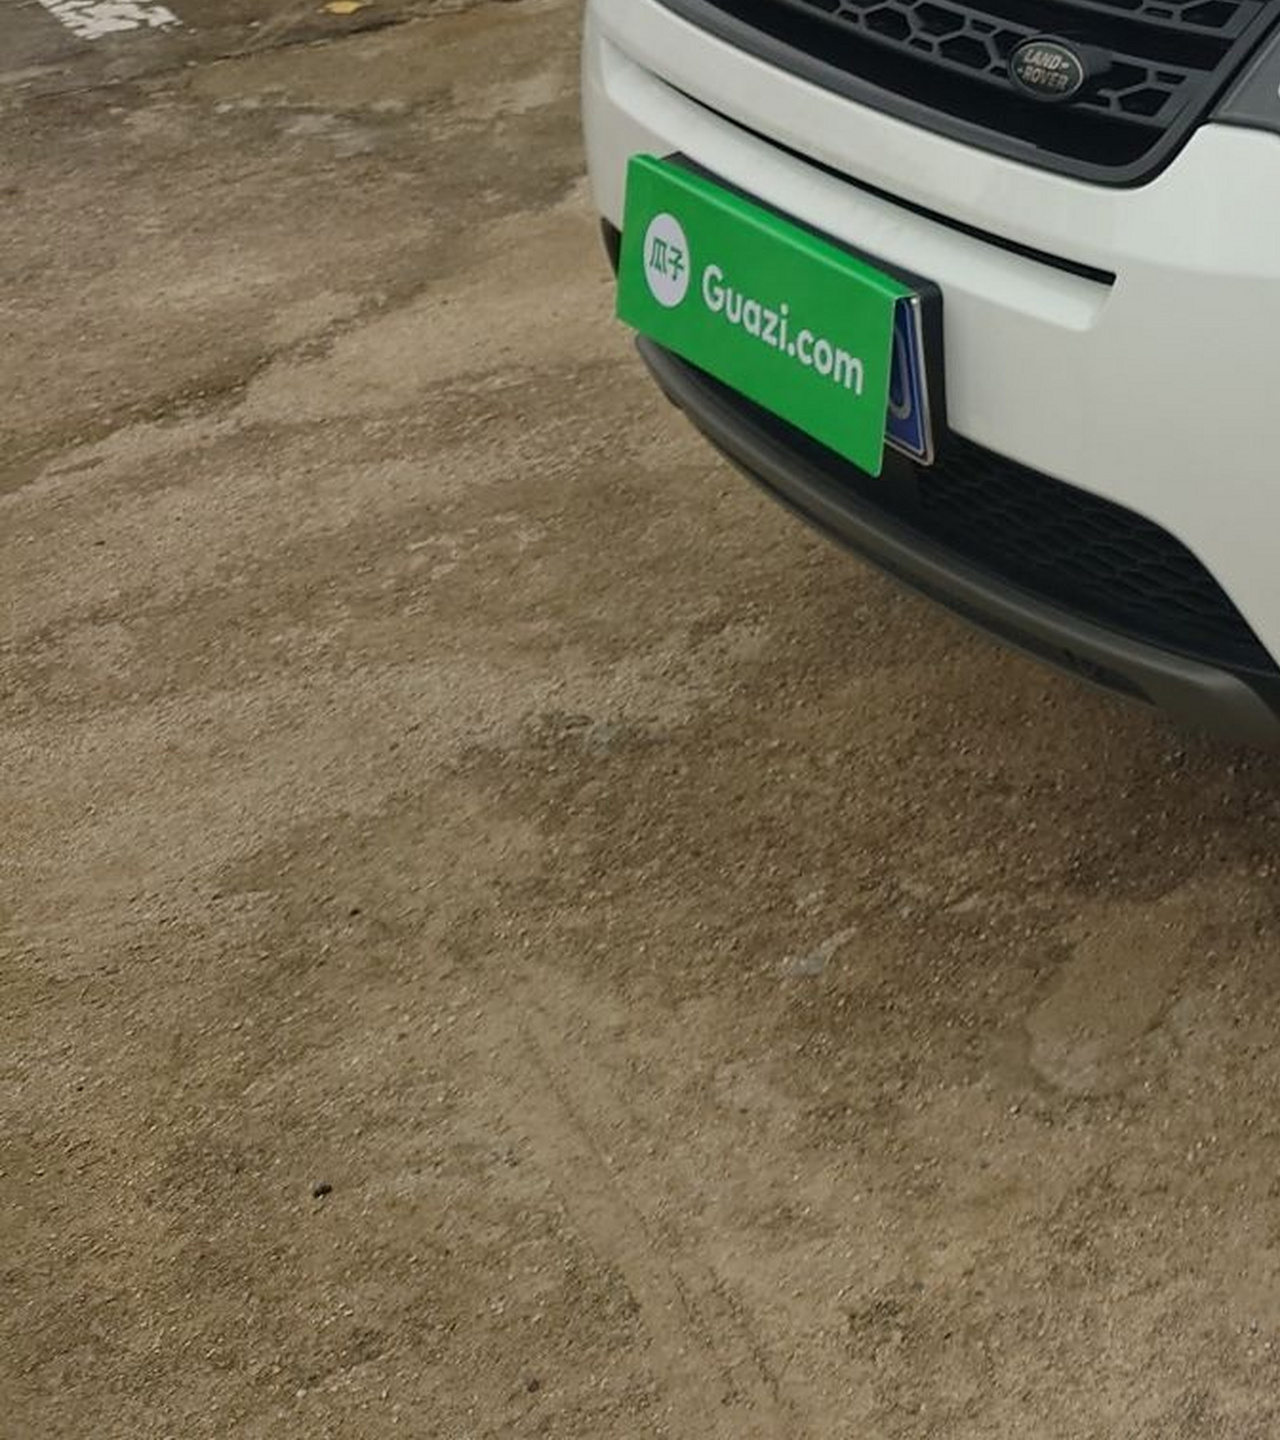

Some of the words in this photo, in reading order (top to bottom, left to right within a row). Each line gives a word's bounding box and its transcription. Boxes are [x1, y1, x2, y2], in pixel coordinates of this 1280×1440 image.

[1021, 63, 1069, 91] ROVER
[1022, 48, 1063, 70] LAND
[649, 236, 685, 282] 瓜子
[702, 263, 864, 396] Guazi.com
